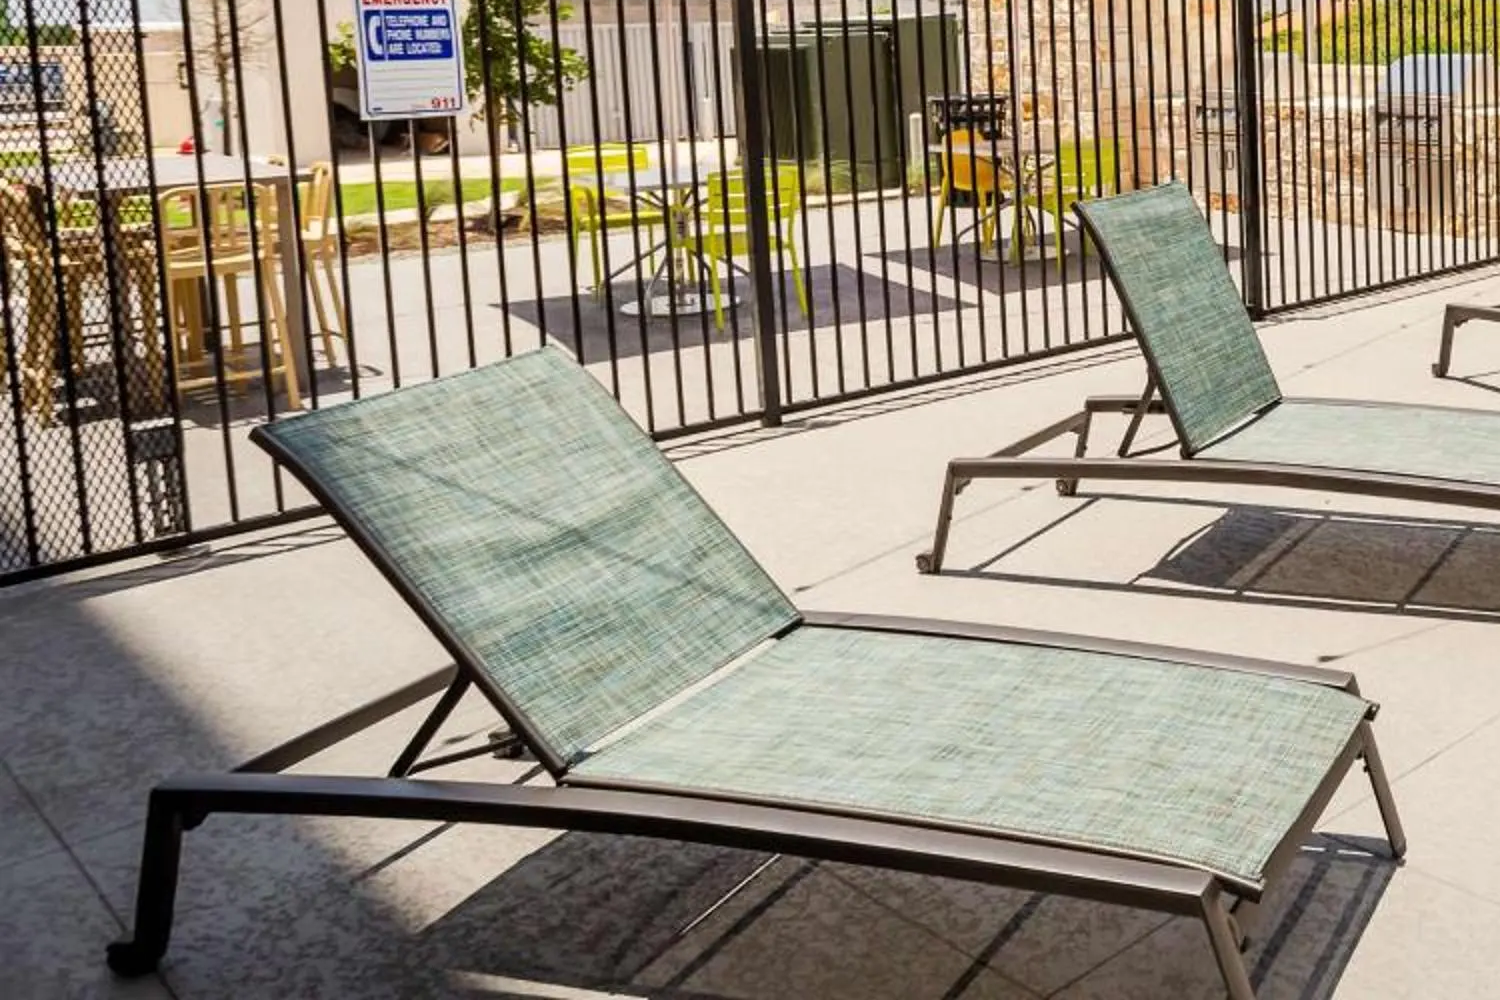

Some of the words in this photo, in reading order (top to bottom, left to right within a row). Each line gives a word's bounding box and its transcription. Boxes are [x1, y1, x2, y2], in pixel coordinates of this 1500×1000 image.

[385, 15, 430, 27] TELEPHONE
[431, 15, 446, 27] AND
[387, 29, 413, 41] PHONE
[415, 28, 450, 41] NUMBERS
[389, 43, 405, 55] ARE
[431, 98, 456, 109] 911
